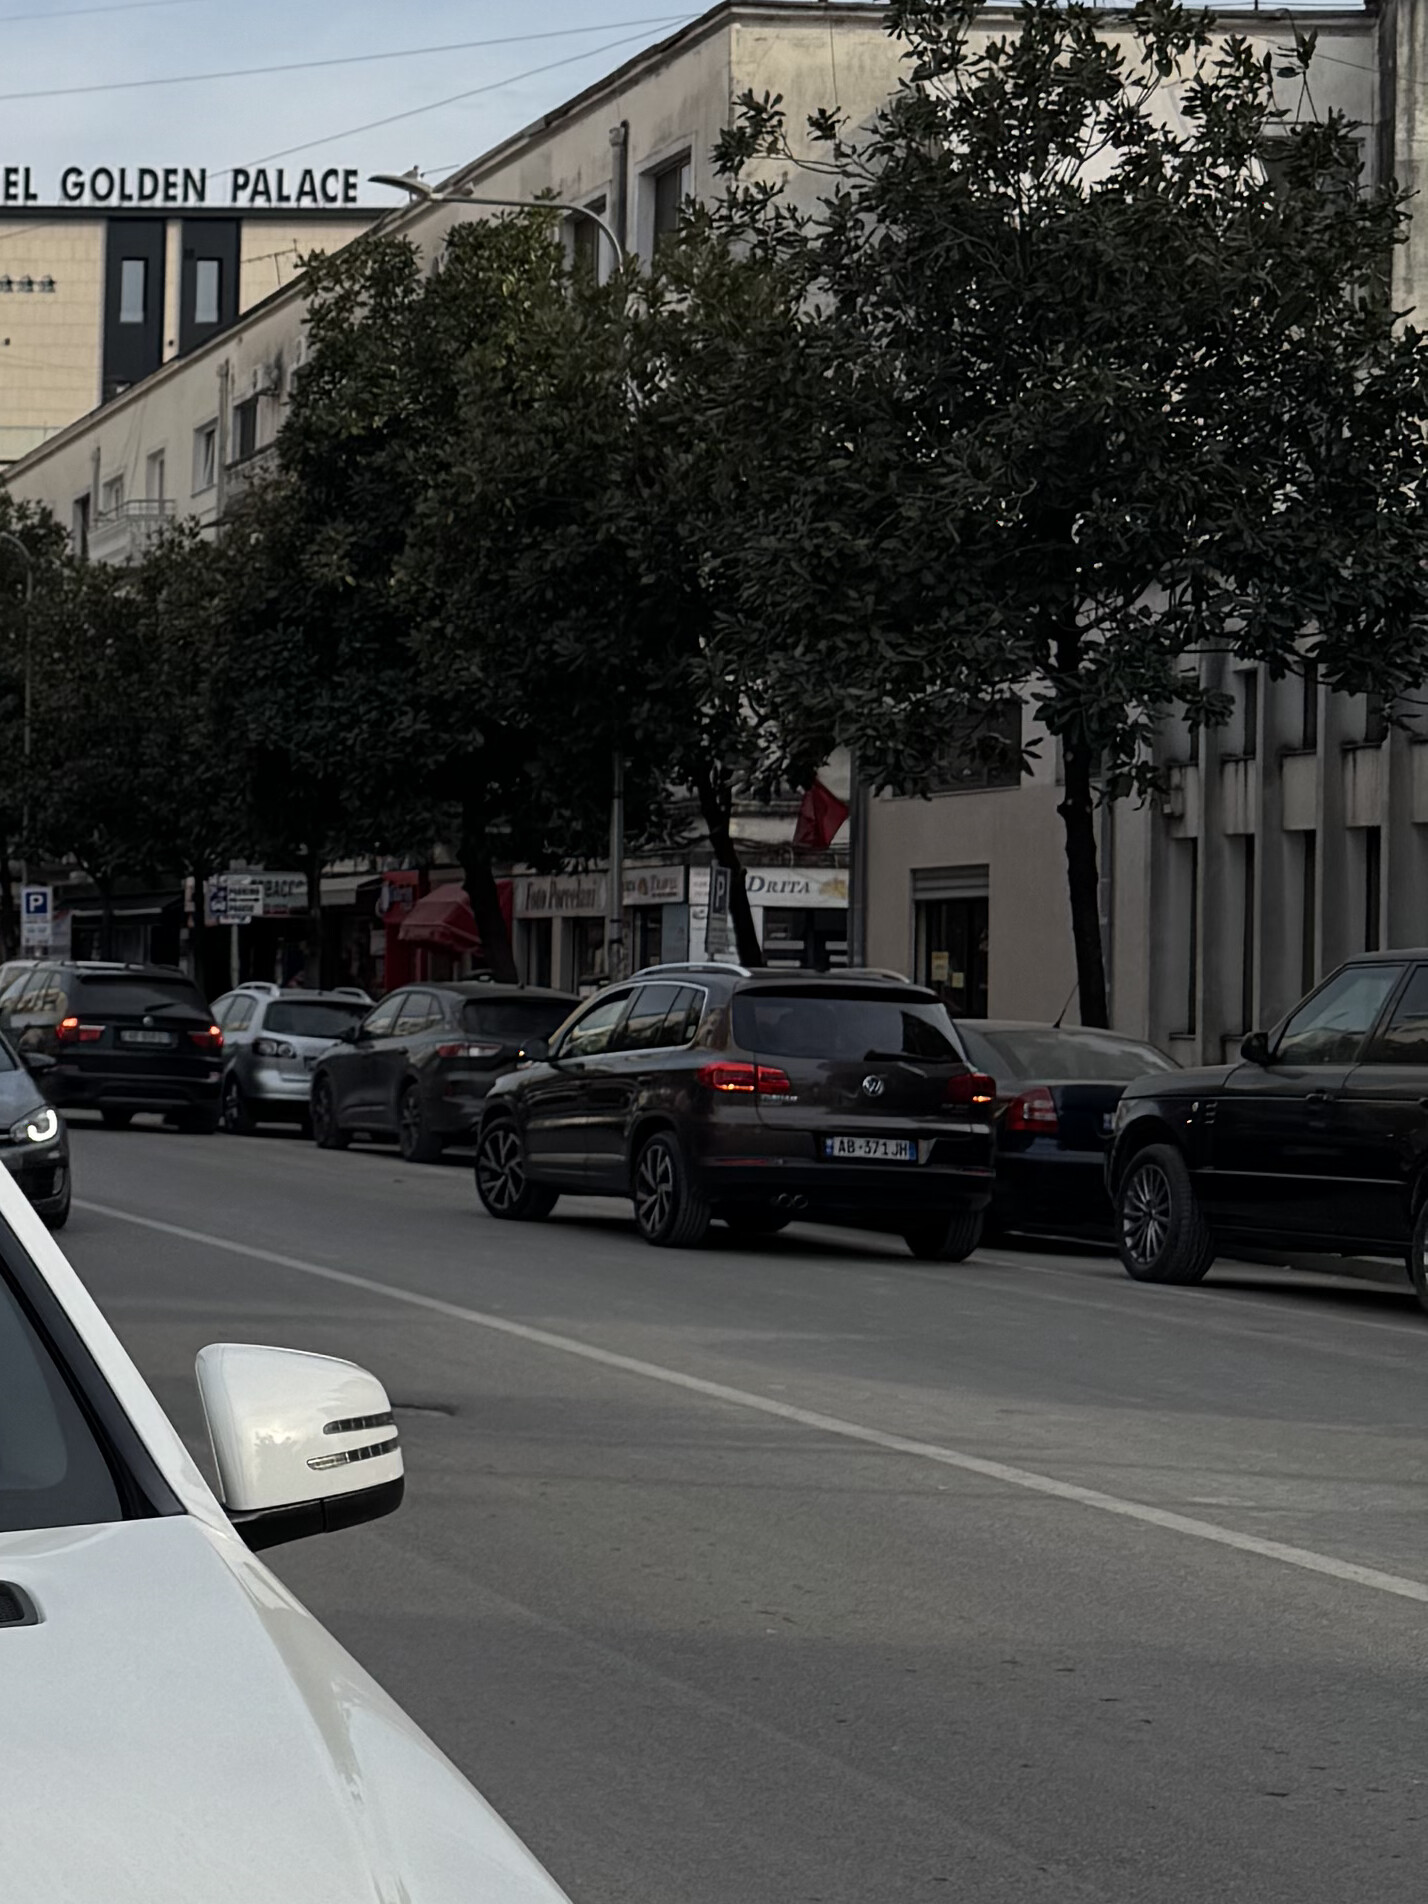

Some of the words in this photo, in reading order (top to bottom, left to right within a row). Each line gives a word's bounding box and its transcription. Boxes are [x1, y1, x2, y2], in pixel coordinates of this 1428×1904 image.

[60, 166, 207, 203] GOLDEN
[231, 167, 359, 204] PALACE
[714, 874, 726, 908] P
[746, 875, 811, 895] DRITA
[28, 895, 44, 912] P
[837, 1139, 856, 1155] AB
